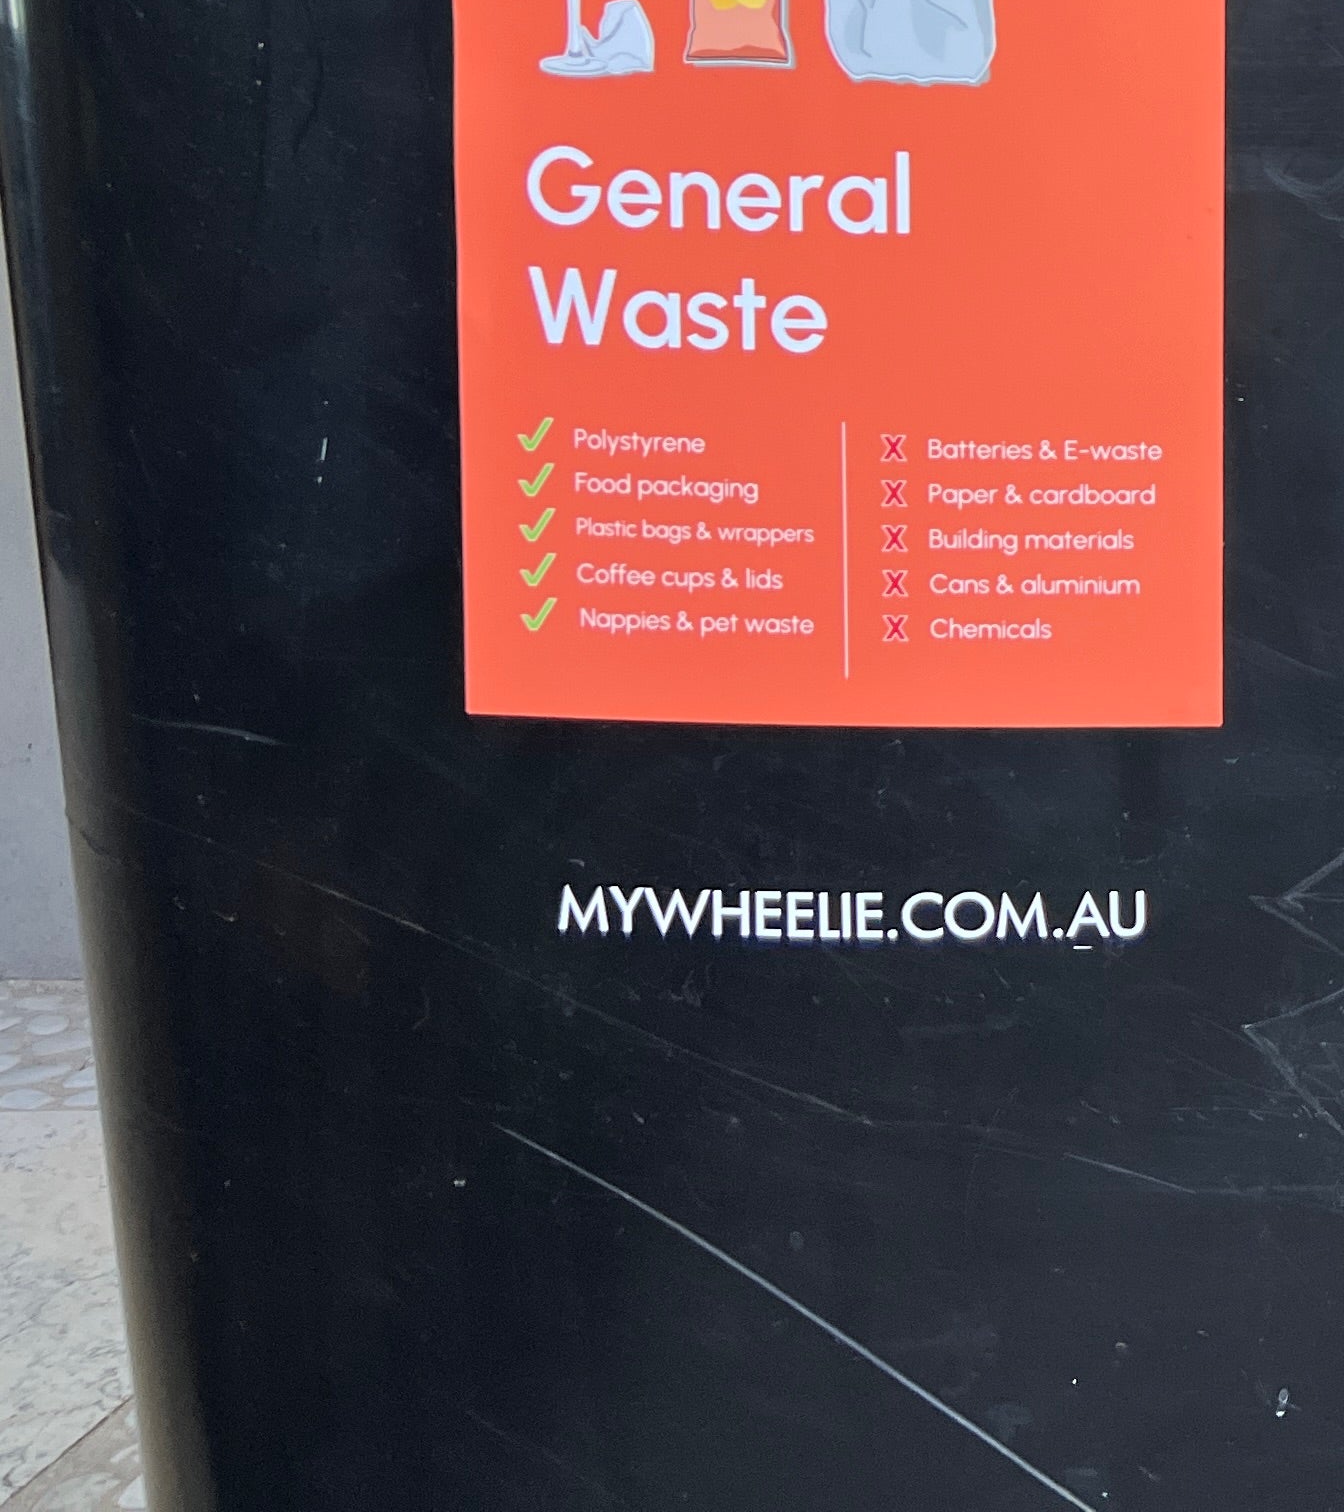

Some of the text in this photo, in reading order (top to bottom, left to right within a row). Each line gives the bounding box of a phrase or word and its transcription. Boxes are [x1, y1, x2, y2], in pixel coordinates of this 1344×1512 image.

[527, 144, 910, 235] General
[527, 265, 828, 353] Waste
[573, 428, 706, 457] Polystyrene
[927, 438, 1162, 461] Batteries & E-waste
[574, 472, 759, 504] Food packaging
[928, 483, 1157, 510] Paper & cardboard
[576, 517, 815, 547] Plastic bags & wrappers
[928, 528, 1134, 556] Building materials
[576, 562, 784, 594] Coffee cups & lids
[929, 573, 1140, 595] Cans & aluminium
[579, 607, 815, 638] Nappies & pet waste
[930, 618, 1052, 640] Chemicals
[557, 884, 1147, 941] MYWHEELIE.COM.AU
